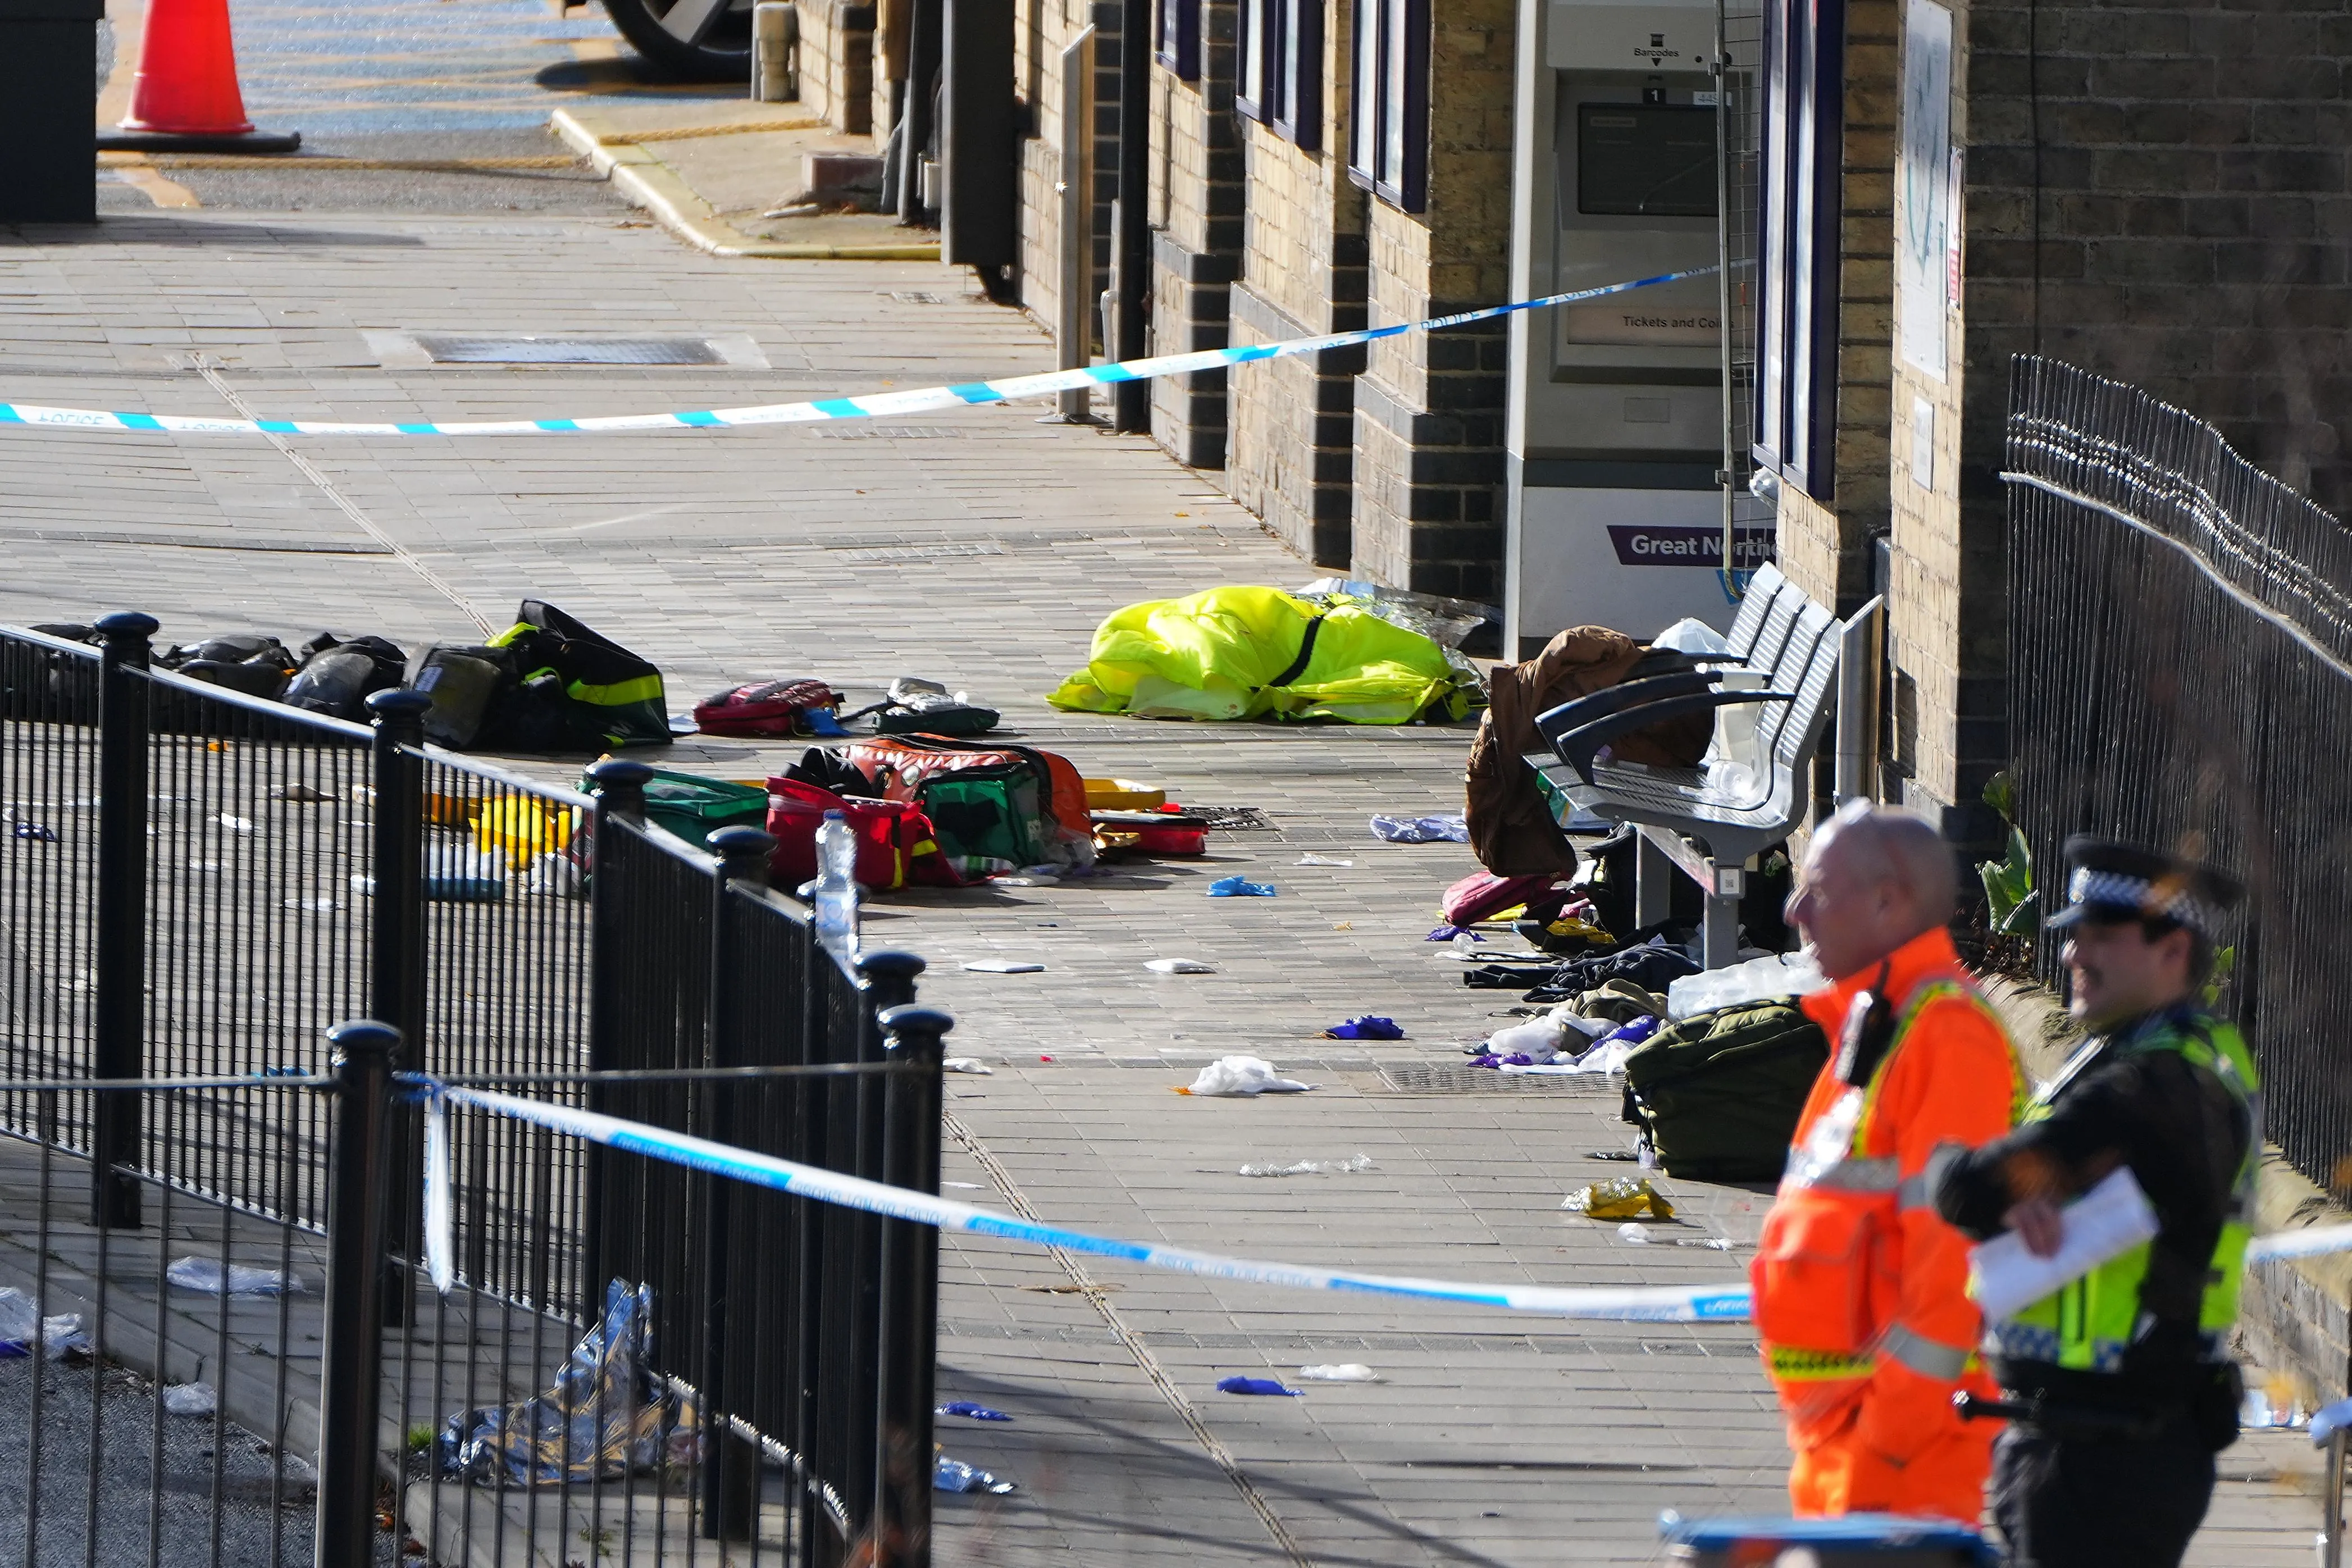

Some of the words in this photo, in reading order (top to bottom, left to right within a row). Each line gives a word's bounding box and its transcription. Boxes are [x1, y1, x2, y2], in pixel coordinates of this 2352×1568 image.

[1634, 48, 1679, 57] Barcodes
[1651, 90, 1658, 102] 1
[1623, 316, 1667, 327] Tickets
[1671, 318, 1694, 327] and
[1698, 317, 1734, 328] Cois
[1631, 535, 1697, 555] Great
